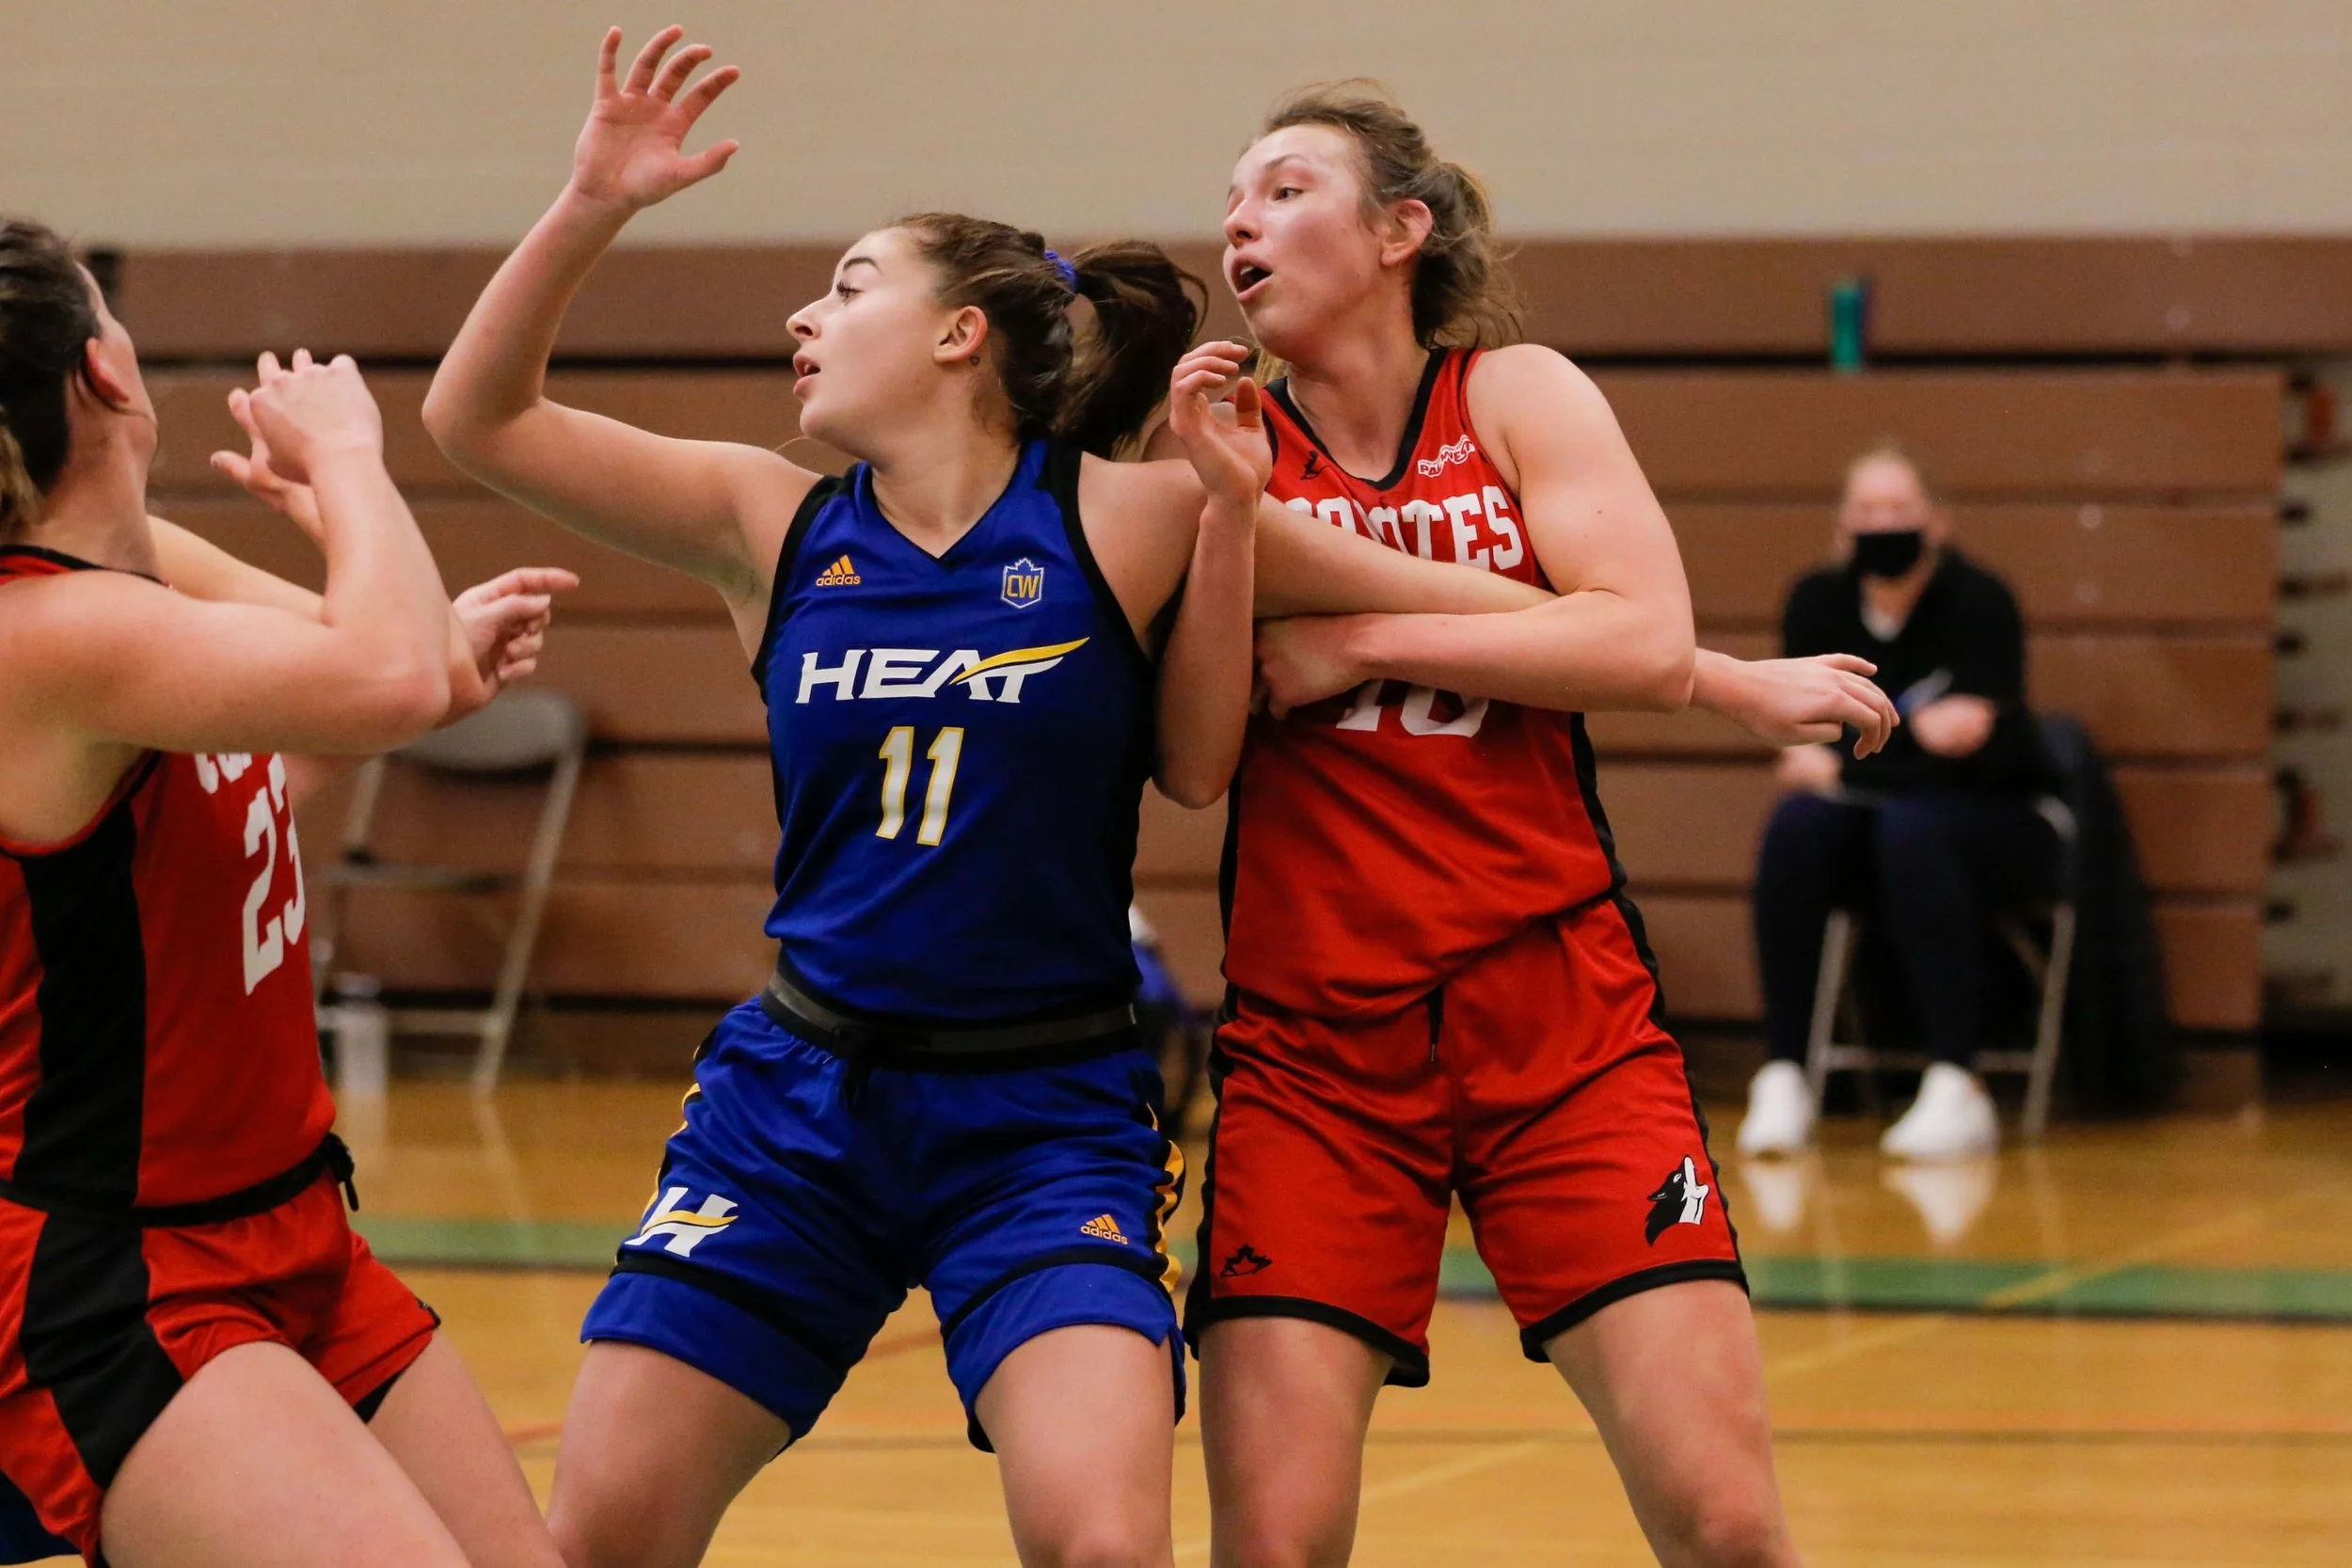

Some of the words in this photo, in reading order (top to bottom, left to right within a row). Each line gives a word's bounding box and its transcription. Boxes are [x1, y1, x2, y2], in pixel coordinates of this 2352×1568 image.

[816, 574, 861, 586] adidas
[1007, 575, 1040, 598] CW
[795, 637, 1089, 704] HEAT
[876, 726, 964, 846] 11
[625, 1187, 739, 1258] H
[1081, 1225, 1128, 1245] adidas
